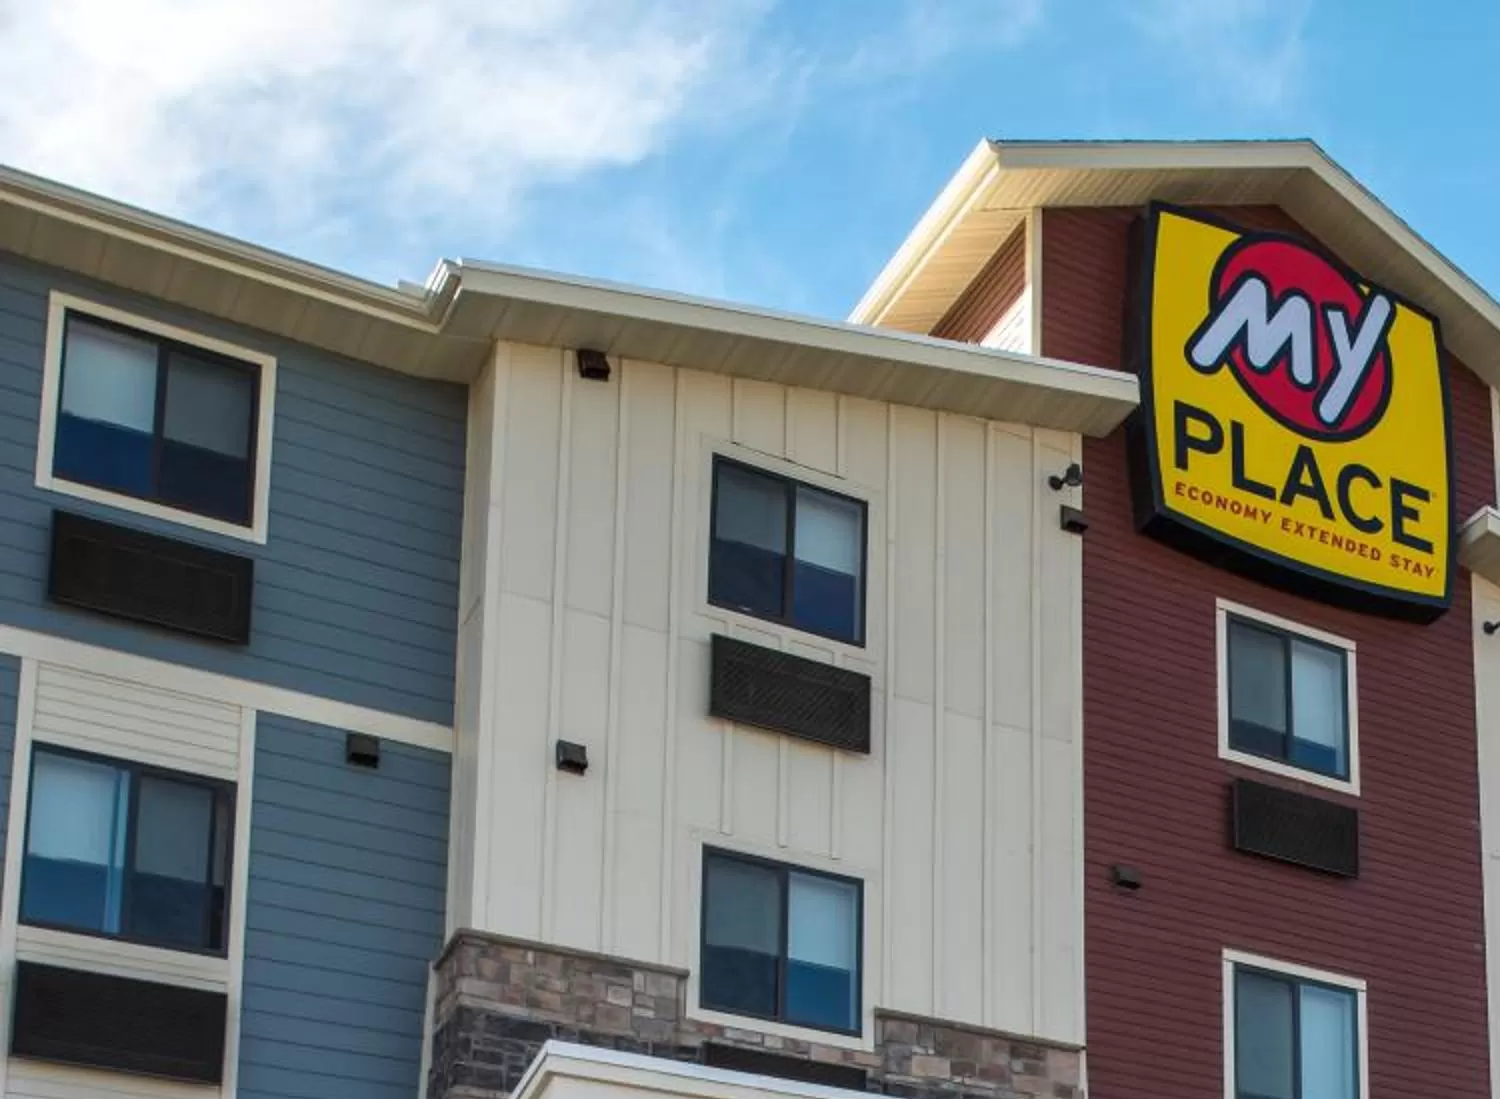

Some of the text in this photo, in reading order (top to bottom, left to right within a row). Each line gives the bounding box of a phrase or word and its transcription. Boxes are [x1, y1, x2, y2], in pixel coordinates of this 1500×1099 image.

[1173, 399, 1435, 555] PLACE
[1174, 481, 1435, 579] ECONOMY EXTENDED STAY
